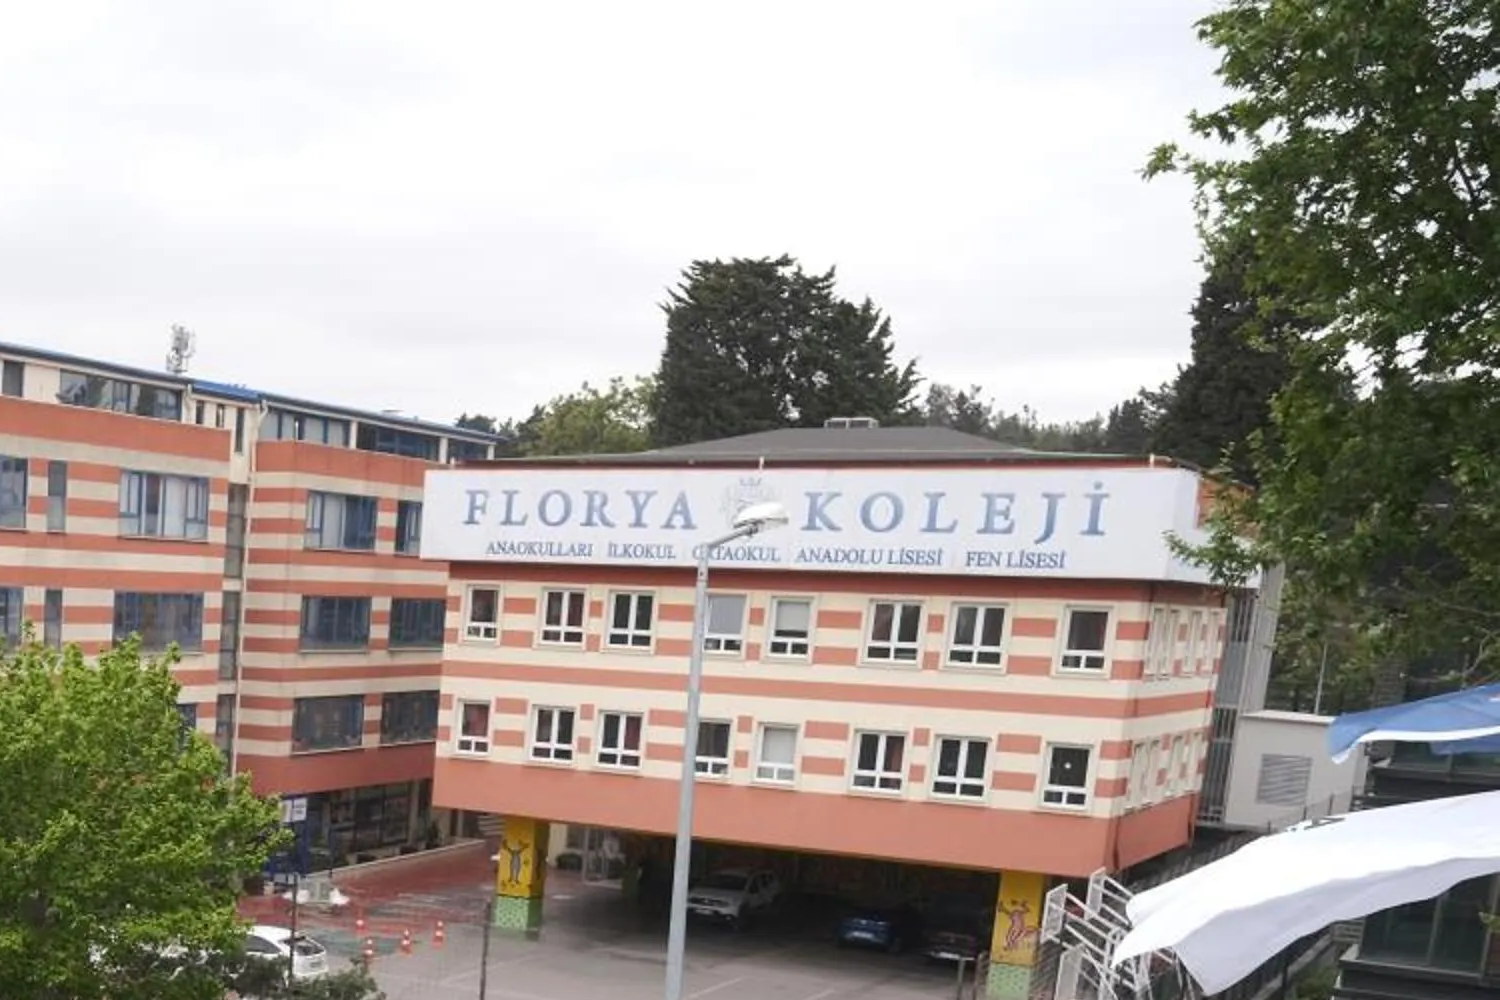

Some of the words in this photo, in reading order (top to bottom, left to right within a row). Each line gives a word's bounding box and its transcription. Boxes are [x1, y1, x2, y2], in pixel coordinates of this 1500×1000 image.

[462, 488, 698, 530] FLORYA
[800, 481, 1111, 545] KOLEJİ
[485, 540, 594, 557] ANAOKULLARI
[607, 540, 677, 559] İLKOKUL
[795, 546, 883, 565] ANADOLU
[887, 545, 945, 566] LİSESİ
[965, 550, 1003, 568] FEN
[1005, 548, 1067, 569] LİSESİ
